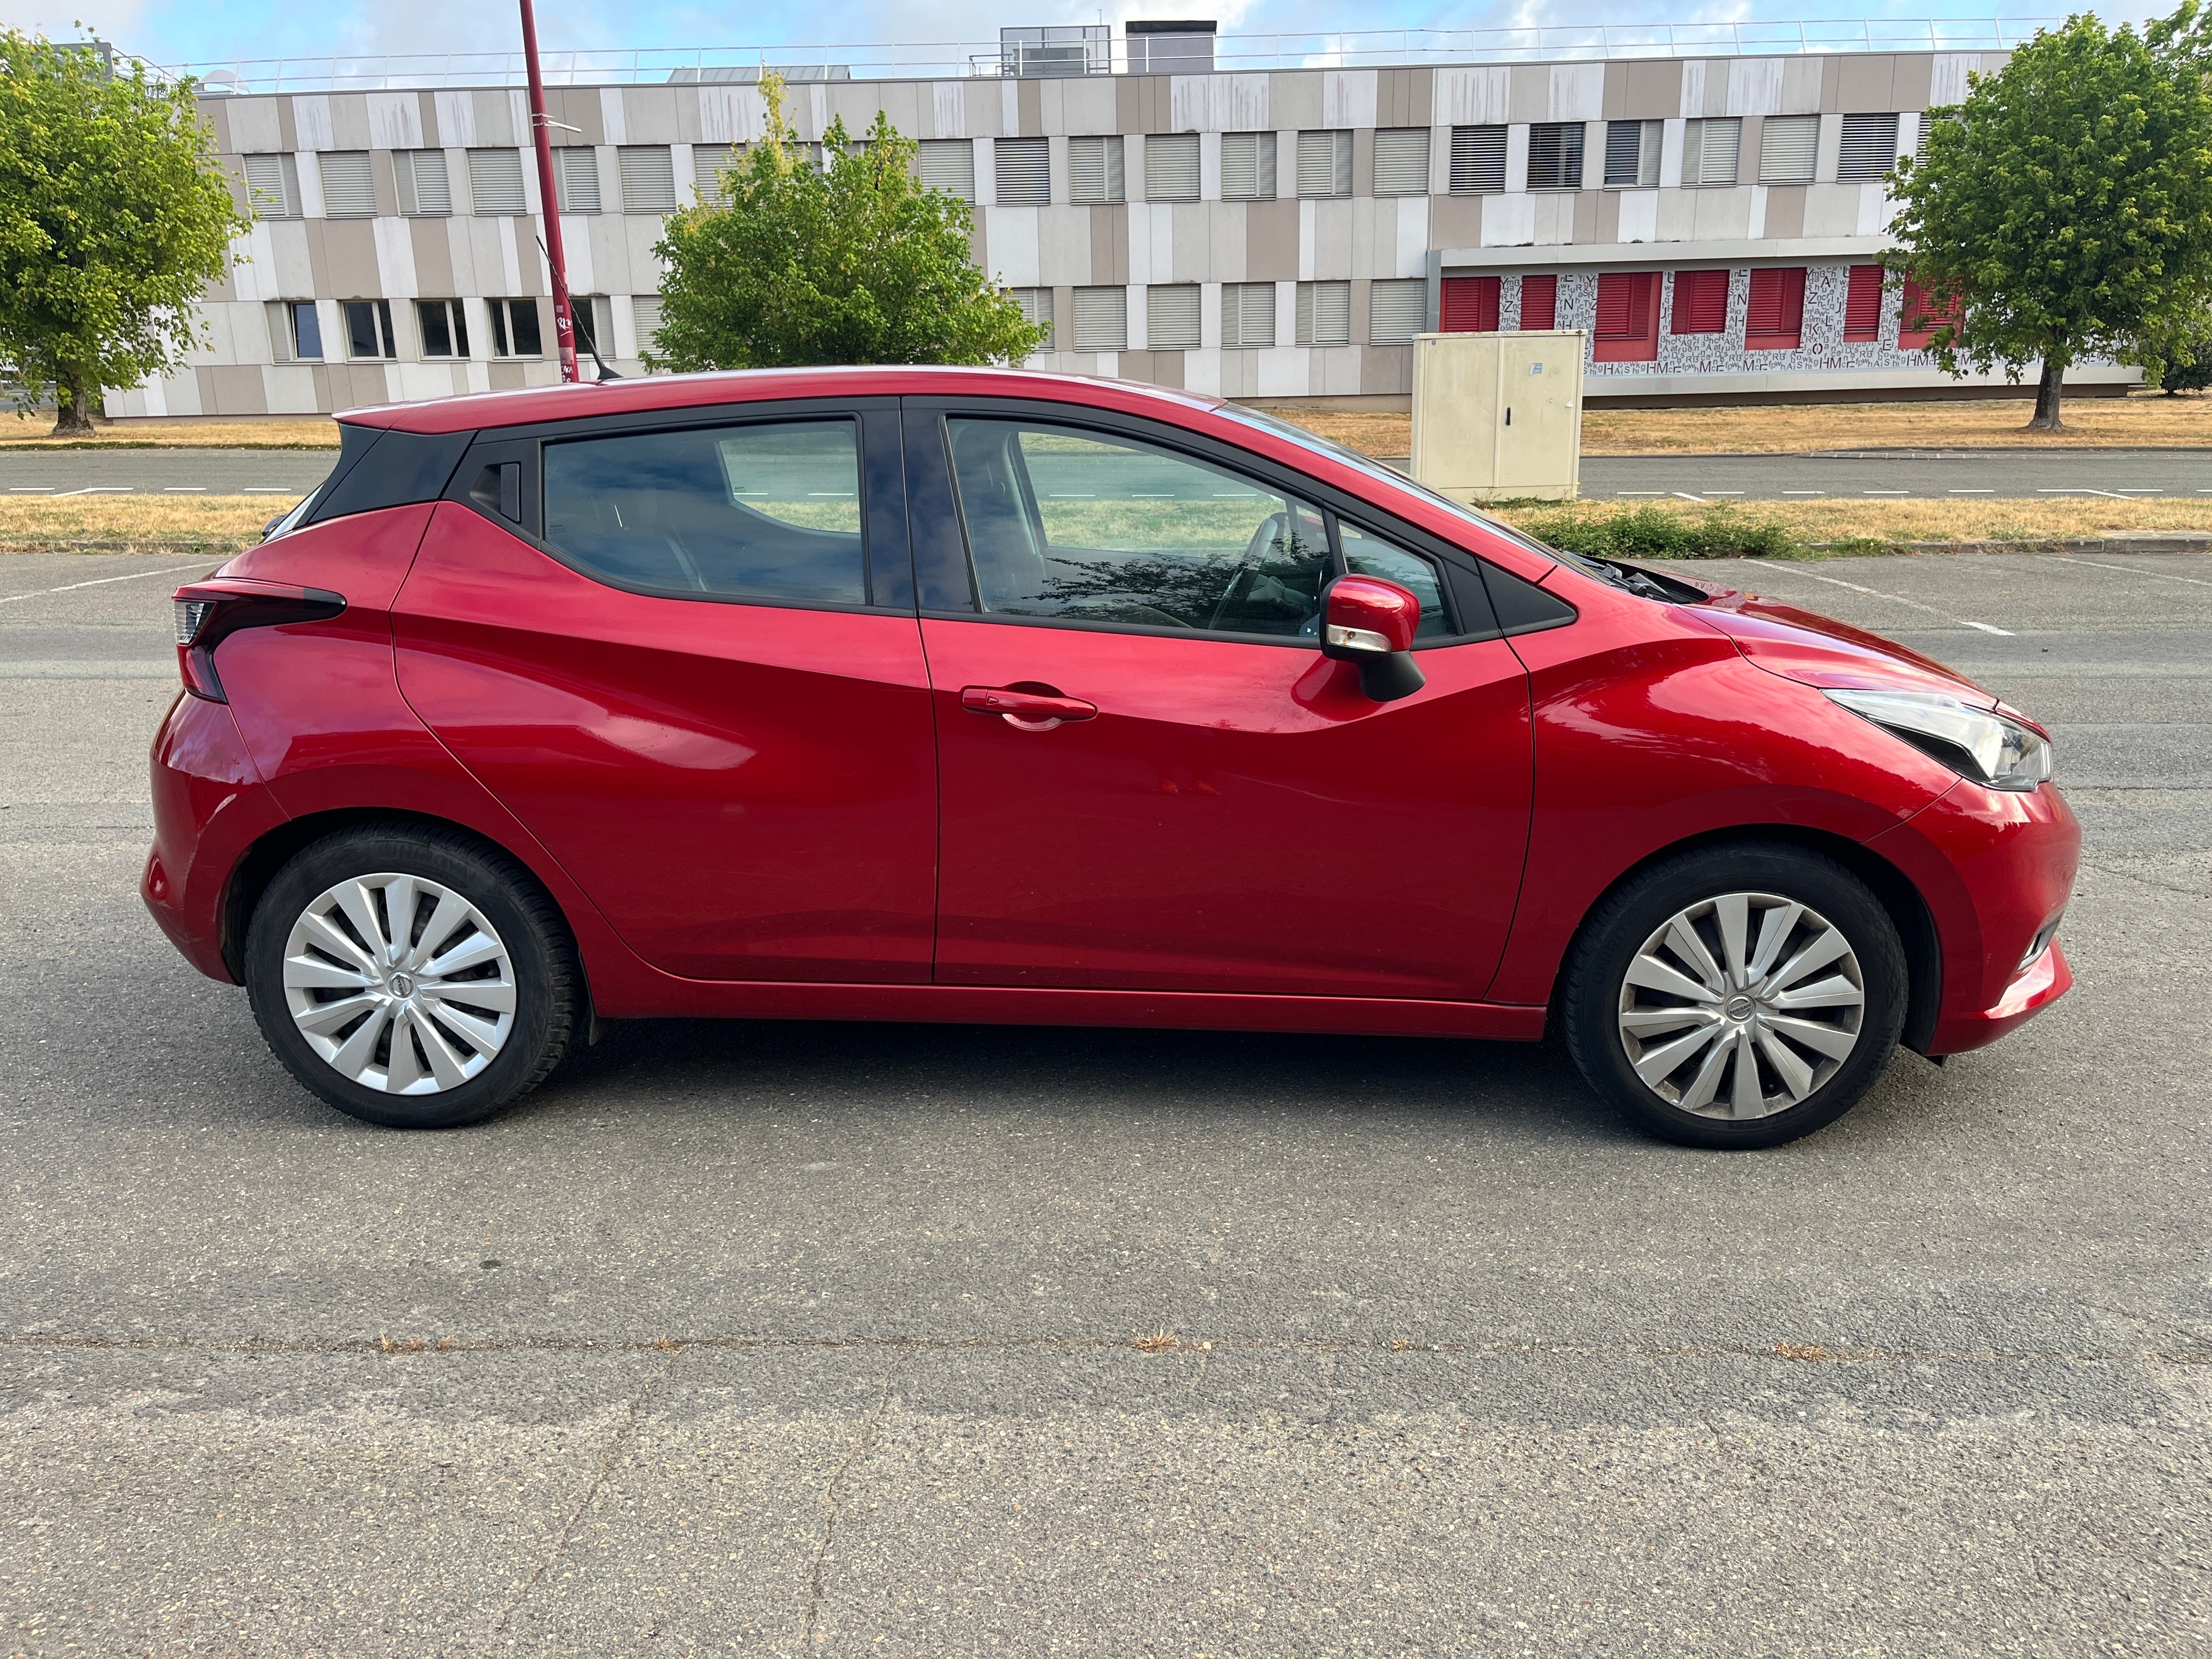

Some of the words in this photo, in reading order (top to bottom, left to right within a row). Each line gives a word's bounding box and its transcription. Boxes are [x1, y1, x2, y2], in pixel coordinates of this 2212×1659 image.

[1587, 275, 1595, 287] Y
[1820, 276, 1830, 287] A
[1737, 294, 1747, 305] N
[1808, 292, 1818, 303] Z
[1504, 301, 1513, 312] Z
[1564, 298, 1573, 310] N
[1835, 302, 1841, 313] J
[1661, 307, 1666, 318] J
[1735, 315, 1745, 326] H
[1826, 315, 1832, 326] L
[1810, 323, 1819, 335] K
[1883, 339, 1892, 351] E
[1743, 360, 1754, 371] M
[1820, 358, 1829, 369] H
[1830, 358, 1841, 369] M
[1908, 355, 1916, 366] H
[1917, 355, 1927, 366] M
[1604, 364, 1613, 375] H
[1647, 363, 1656, 374] H
[1657, 362, 1668, 374] M
[1701, 361, 1711, 372] M
[396, 975, 406, 997] NISSAN
[1729, 1001, 1752, 1015] NISSAN
